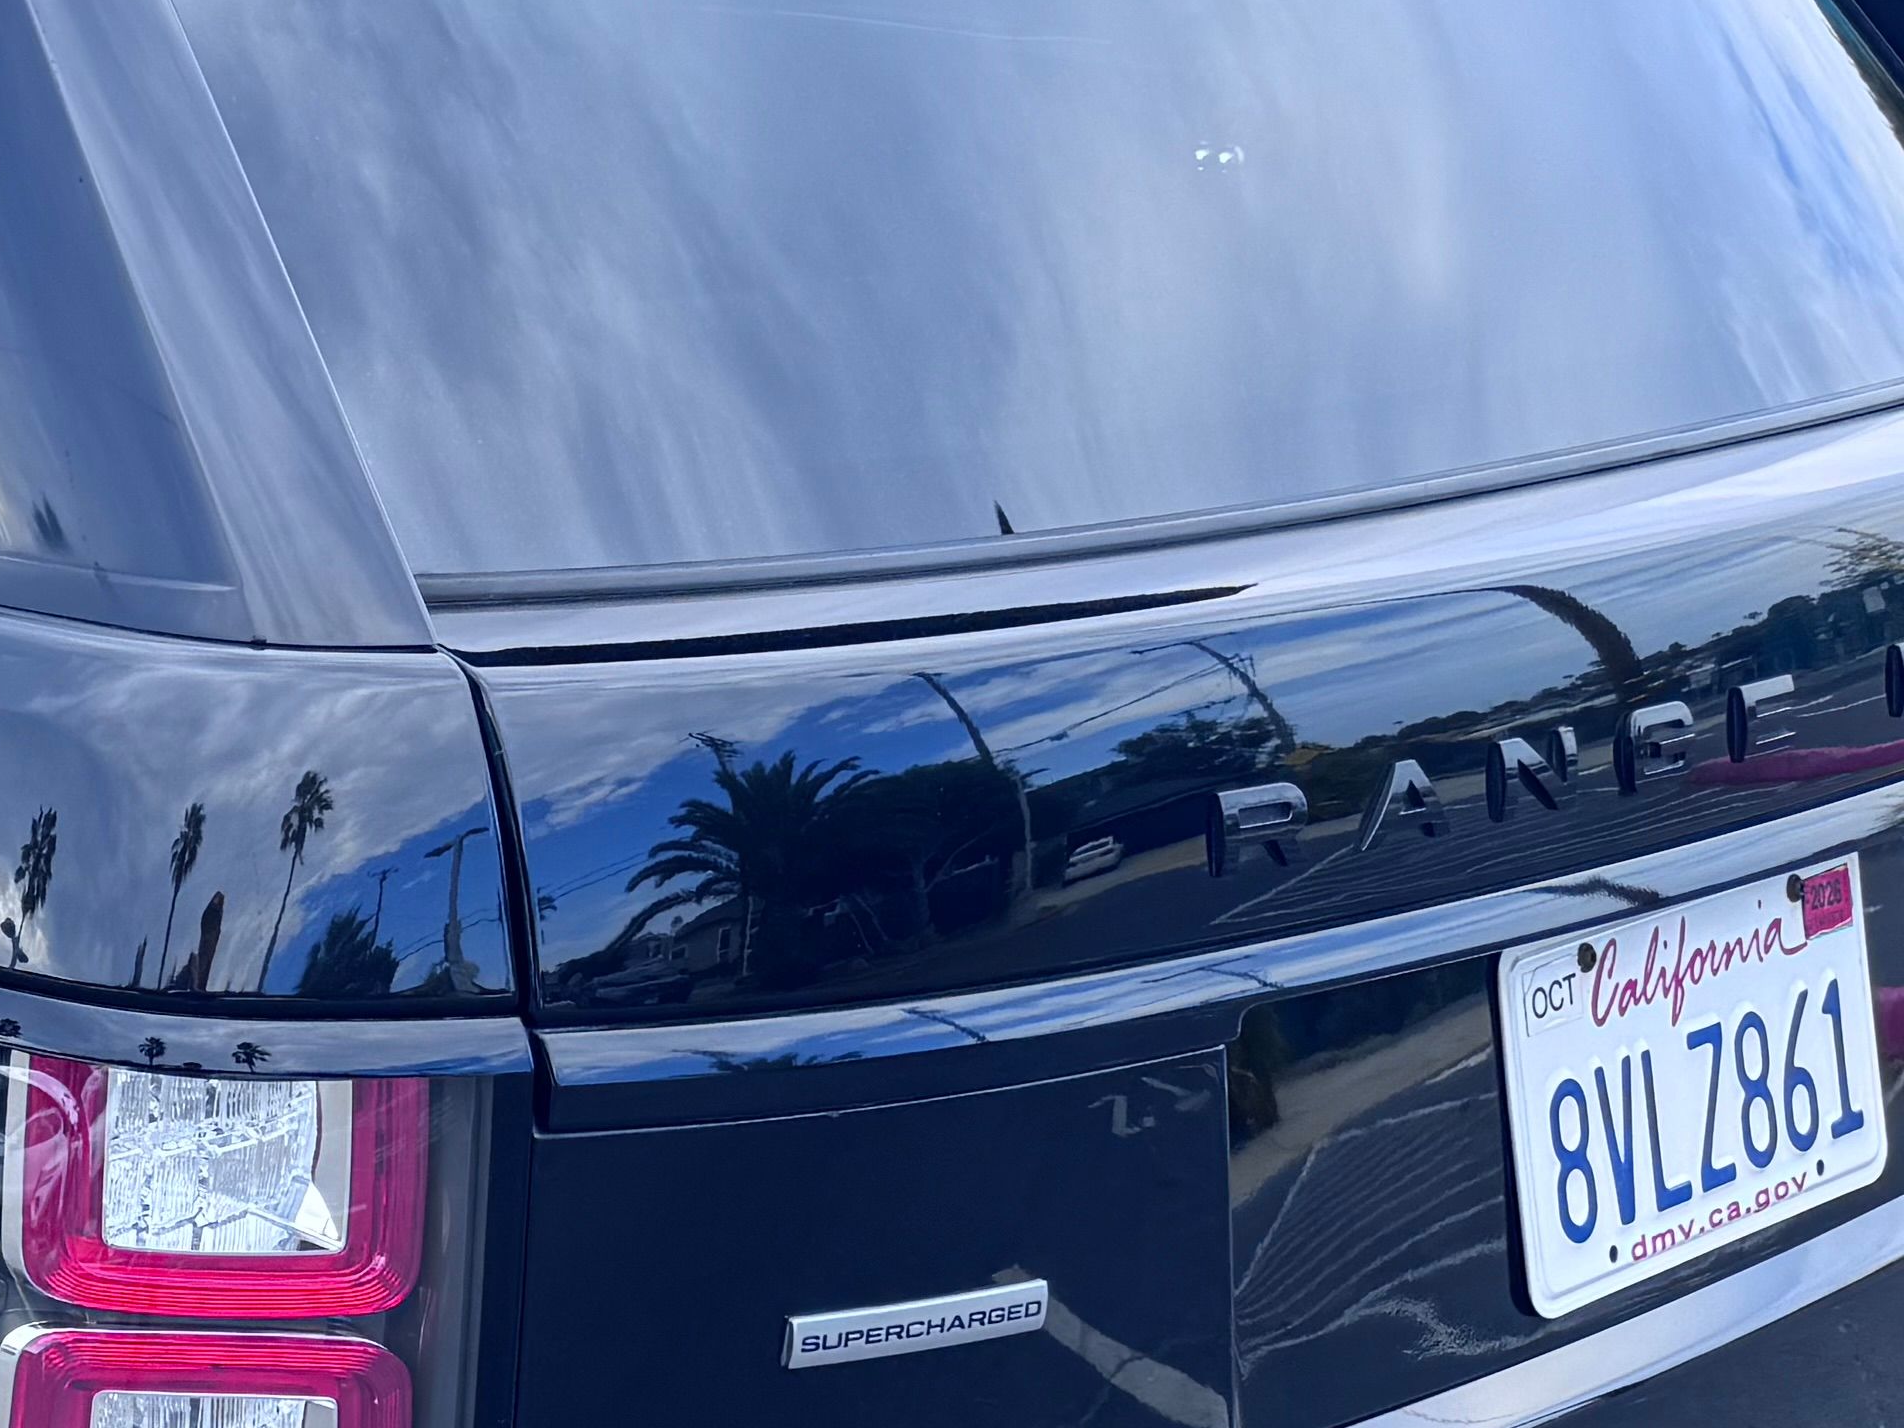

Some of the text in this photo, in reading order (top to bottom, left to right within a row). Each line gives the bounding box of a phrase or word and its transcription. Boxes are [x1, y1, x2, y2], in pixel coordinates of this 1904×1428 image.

[1206, 673, 1795, 877] RANGE
[1531, 973, 1577, 1019] OCT
[1590, 899, 1809, 1028] California
[1548, 977, 1865, 1244] 8VLZ861
[1630, 1171, 1808, 1262] dmv.ca.gov
[799, 1300, 1043, 1353] SUPERCHARGED
